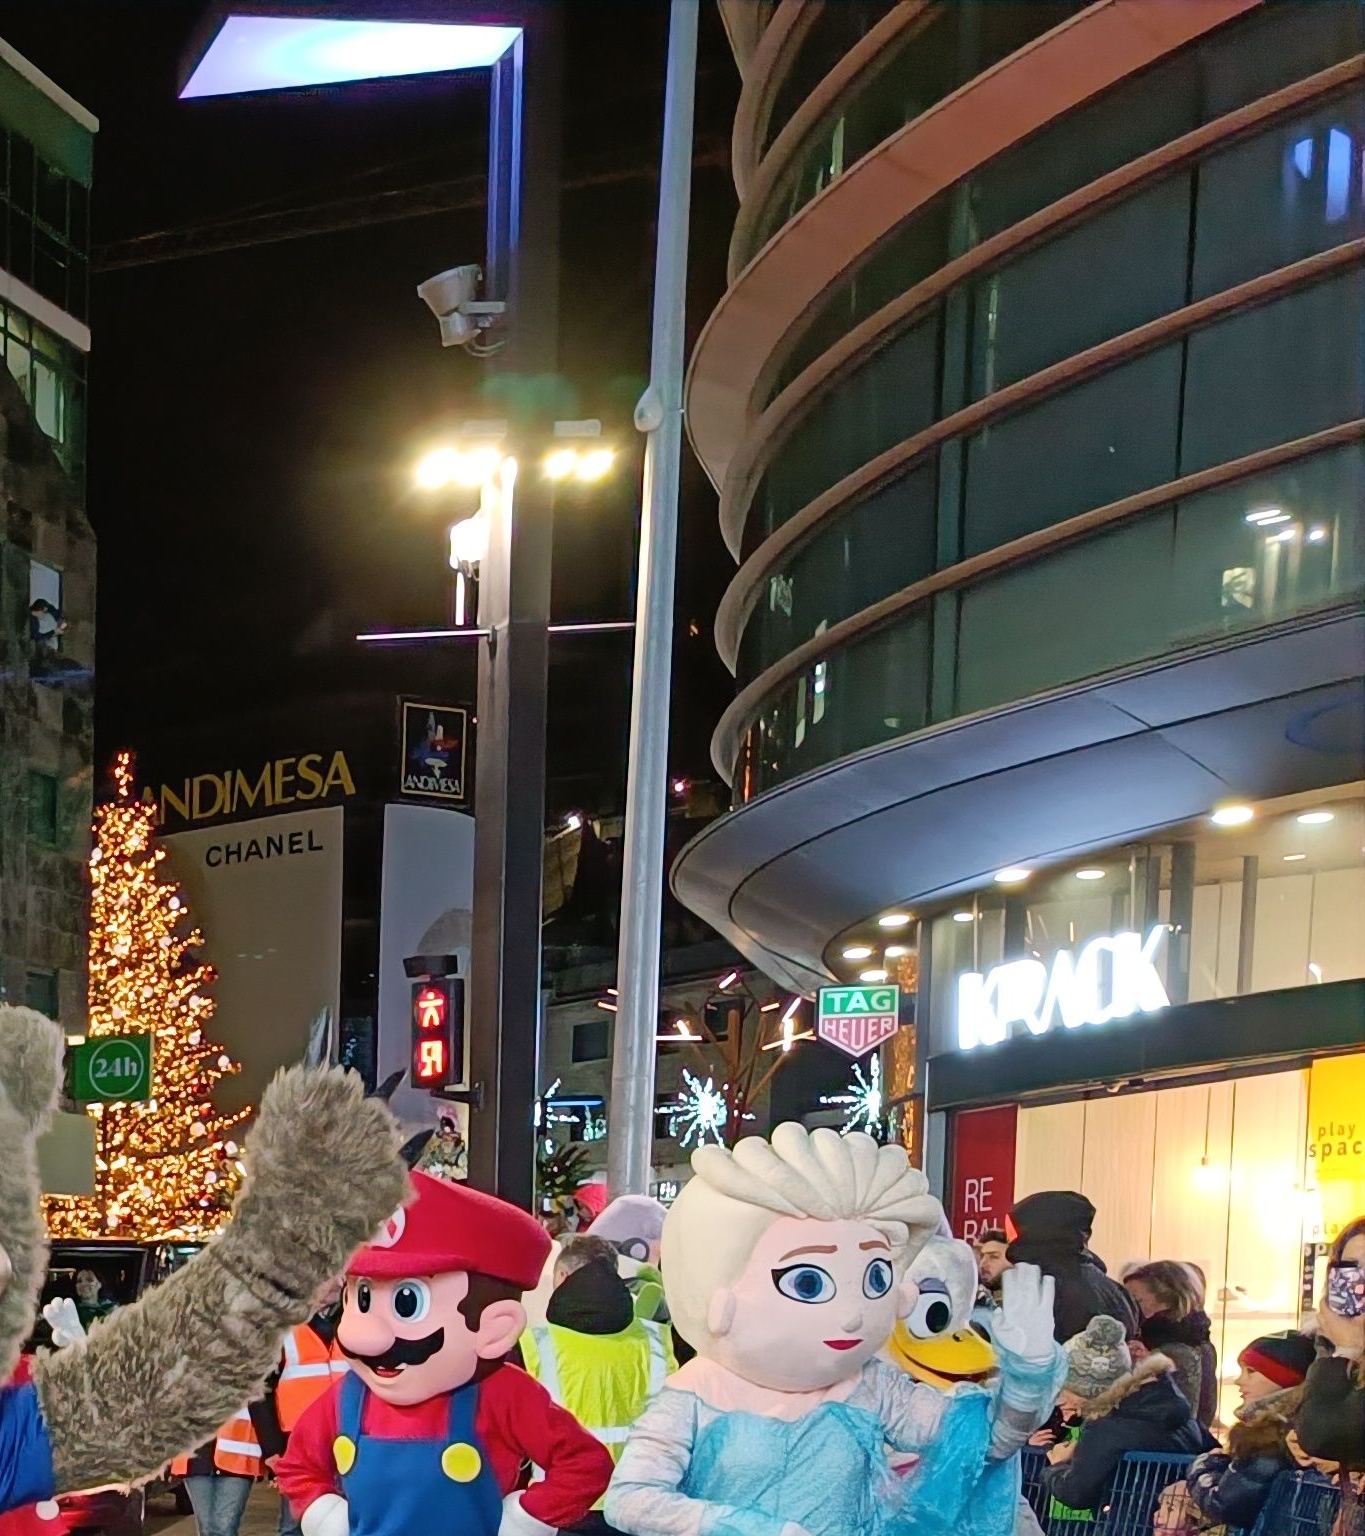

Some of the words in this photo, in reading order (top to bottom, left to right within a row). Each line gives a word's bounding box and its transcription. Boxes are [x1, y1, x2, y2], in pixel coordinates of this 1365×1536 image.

[205, 829, 323, 867] CHANEL
[827, 991, 891, 1013] TAG
[824, 1017, 893, 1050] HEUER
[95, 1056, 137, 1078] 24h
[1318, 1122, 1356, 1141] play
[964, 1176, 994, 1213] RE
